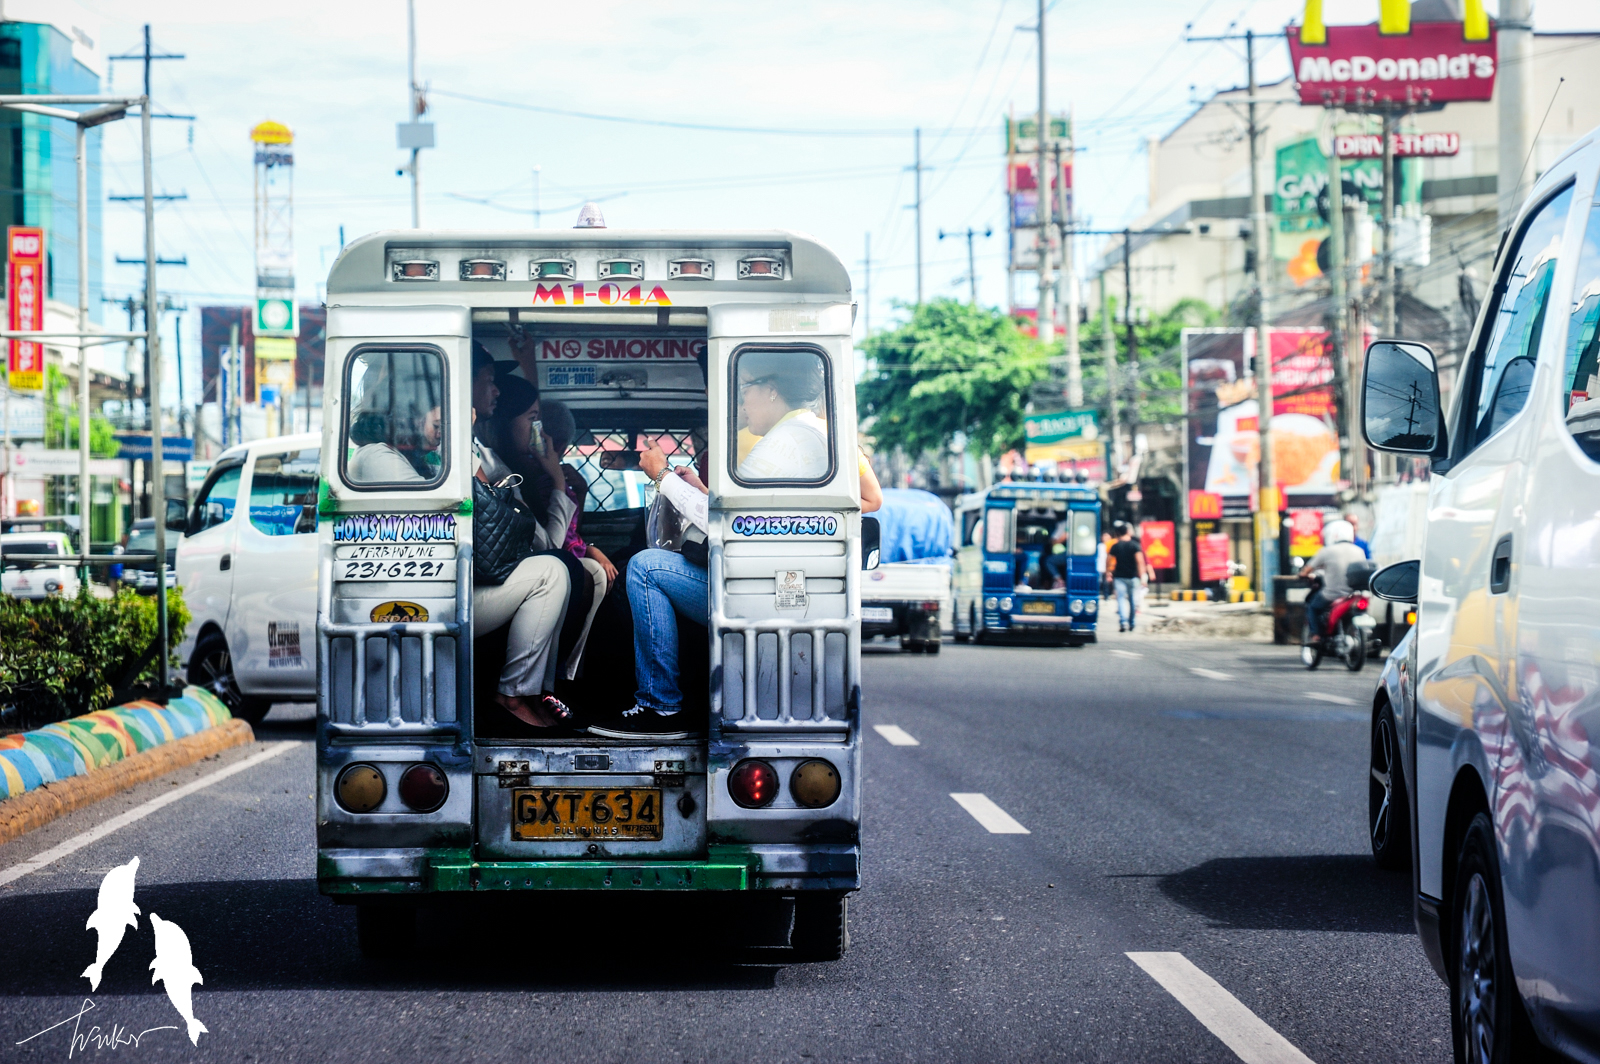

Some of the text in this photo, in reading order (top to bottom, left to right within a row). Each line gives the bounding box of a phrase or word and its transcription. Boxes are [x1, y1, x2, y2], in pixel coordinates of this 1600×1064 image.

[1299, 54, 1494, 82] McDonald's
[12, 236, 39, 254] RD
[532, 282, 673, 306] M1-04A
[19, 265, 33, 372] PAWNSOP
[587, 338, 708, 359] SMOKING
[379, 514, 401, 542] MY
[400, 513, 457, 542] DRIVING
[732, 515, 837, 536] 09213573510
[345, 561, 444, 579] 231-6221
